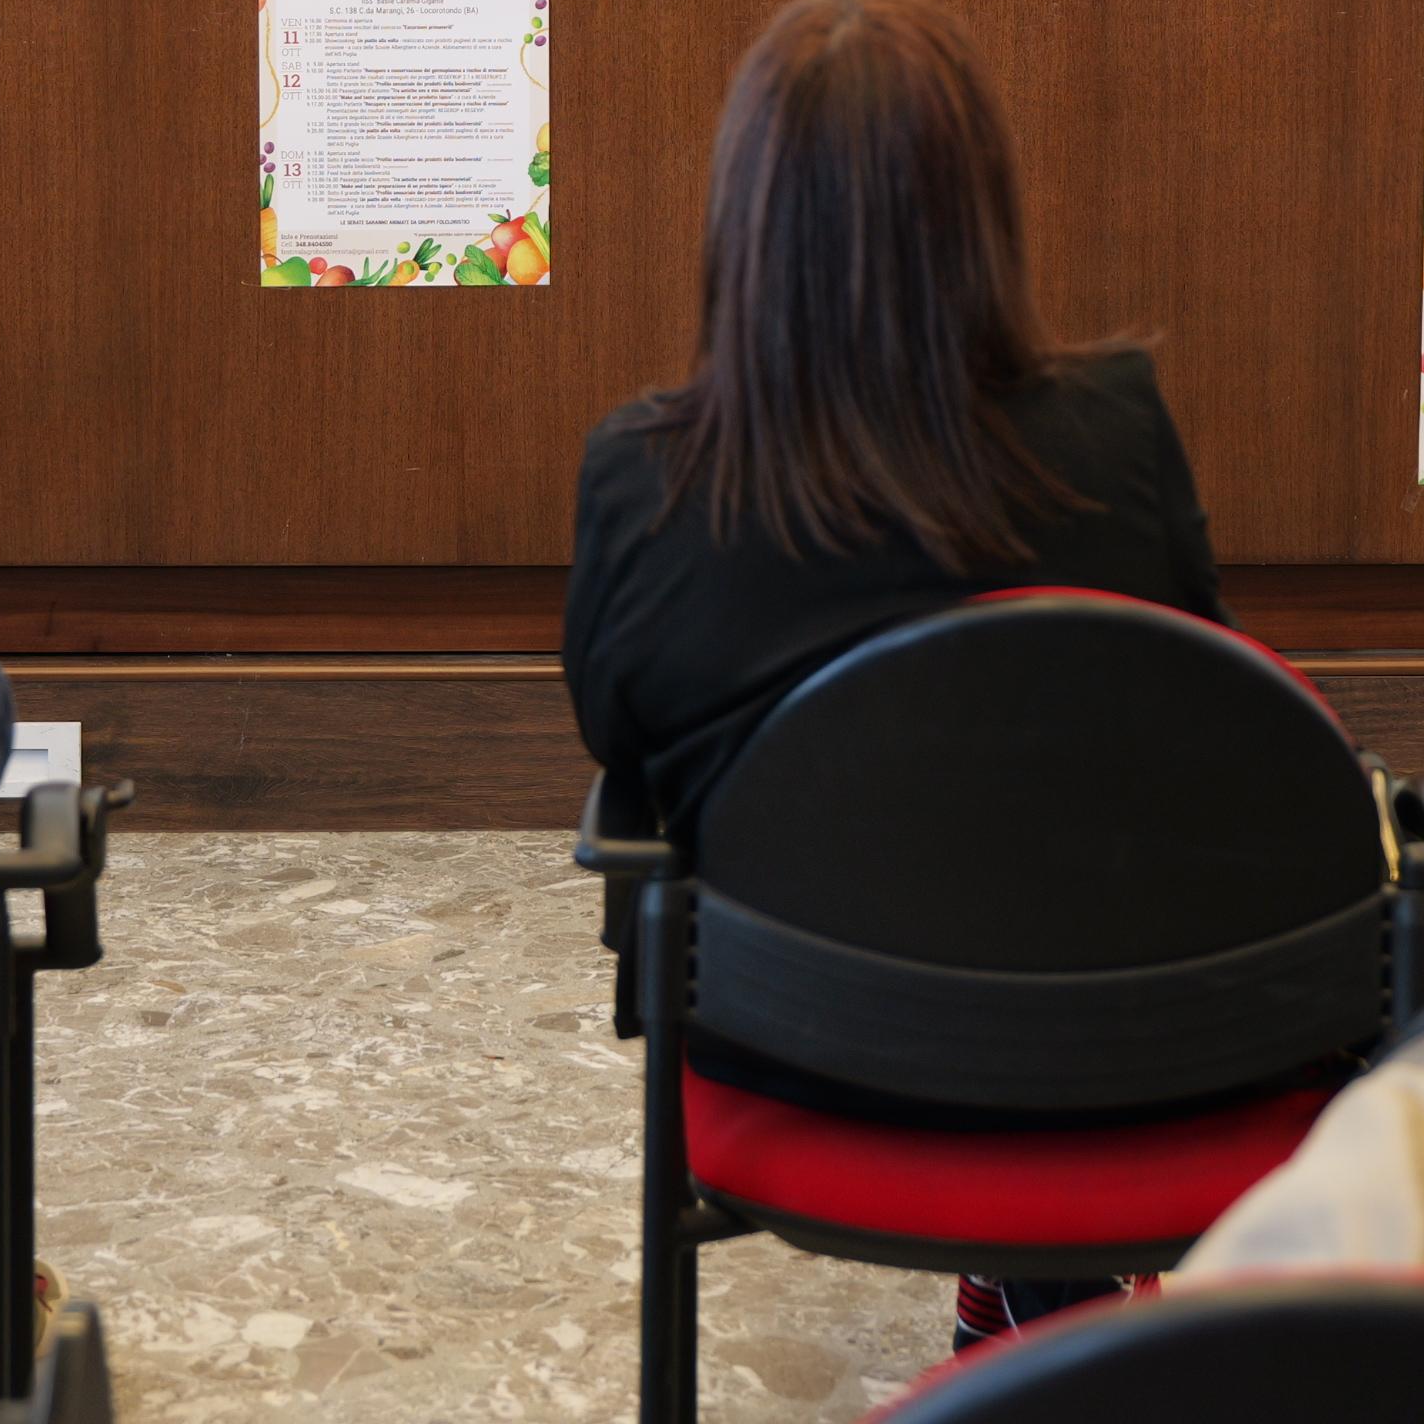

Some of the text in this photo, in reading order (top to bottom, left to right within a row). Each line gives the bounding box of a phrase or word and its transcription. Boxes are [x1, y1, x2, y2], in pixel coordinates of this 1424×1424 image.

[406, 7, 415, 15] 26
[419, 7, 462, 15] Locorotondo
[281, 18, 301, 26] VEN
[284, 31, 299, 44] 11
[281, 62, 302, 70] SAB
[283, 74, 300, 87] 12
[281, 151, 304, 161] DOM
[284, 163, 301, 176] 13
